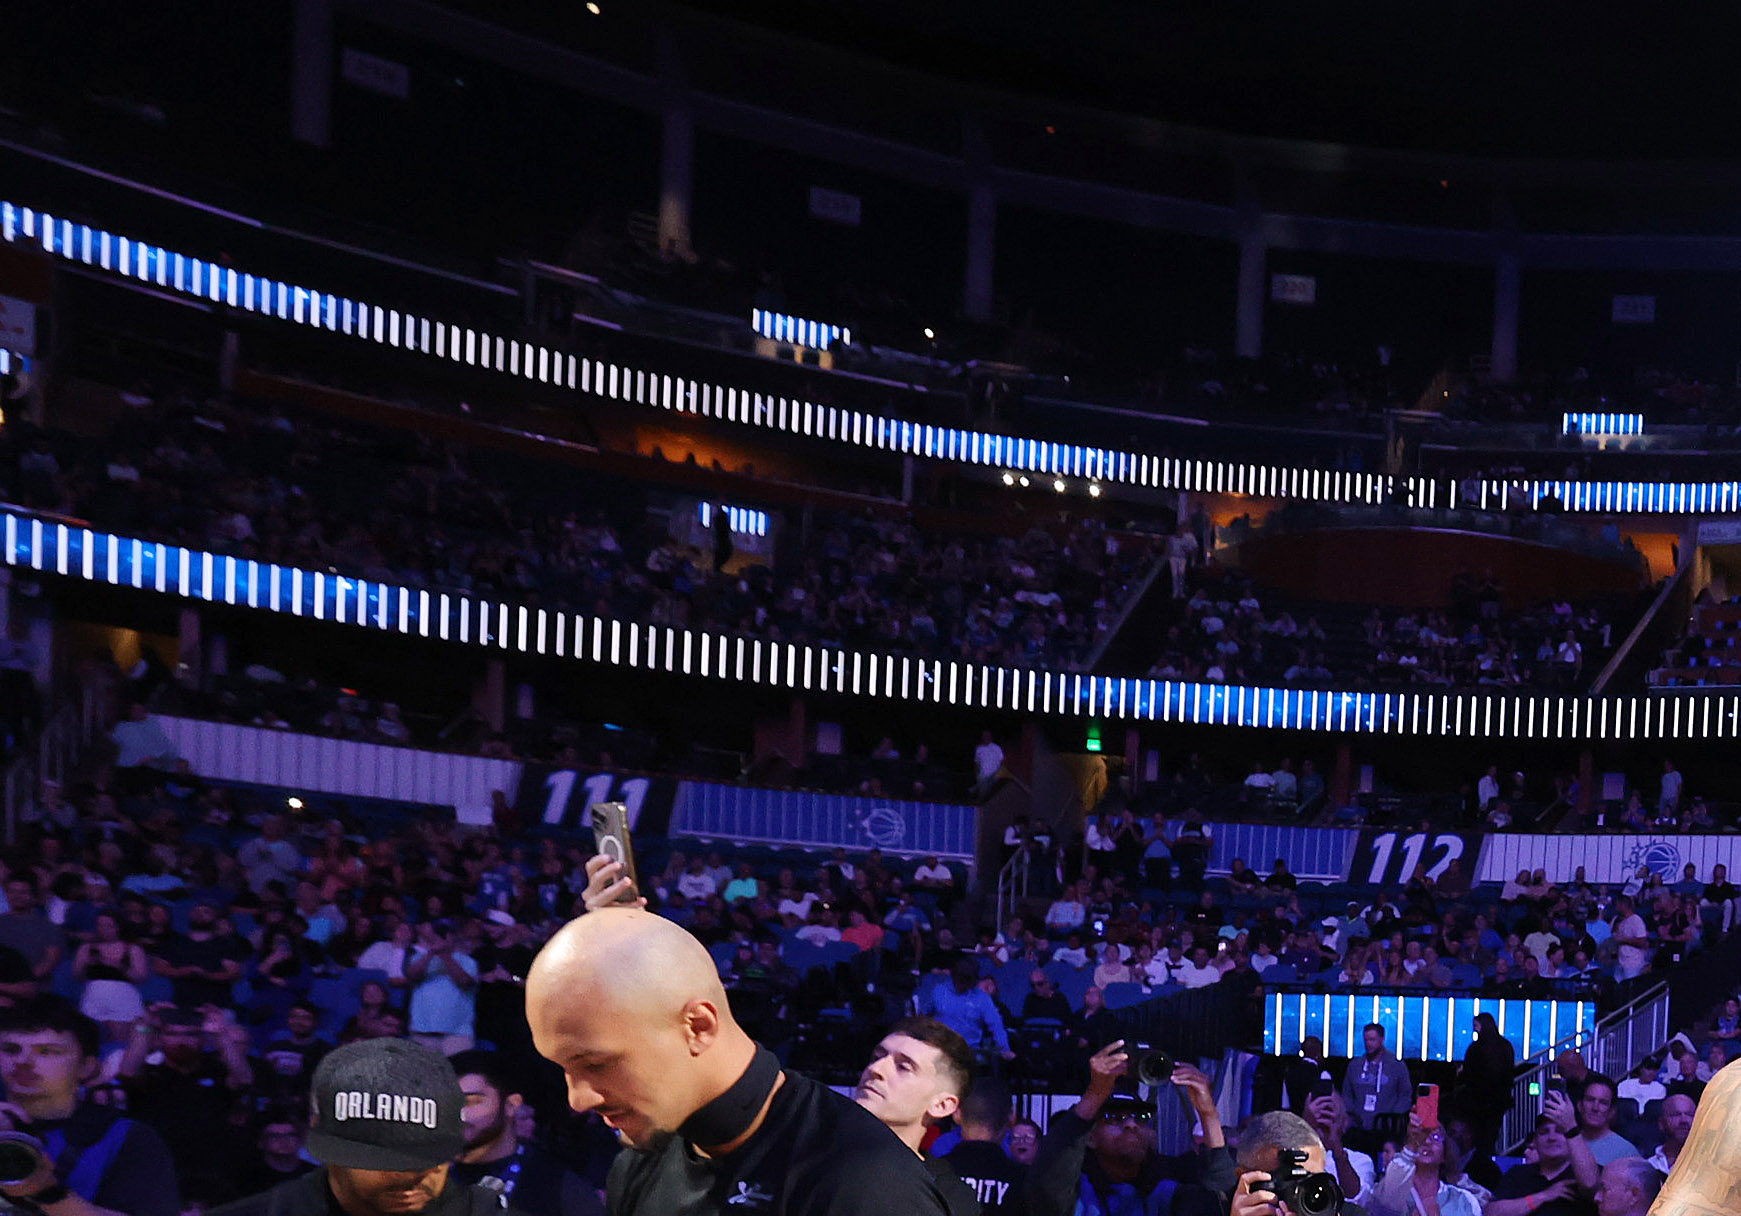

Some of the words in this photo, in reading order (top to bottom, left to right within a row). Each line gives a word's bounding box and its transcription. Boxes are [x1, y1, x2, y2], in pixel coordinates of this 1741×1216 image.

[543, 769, 650, 832] 111
[1367, 832, 1464, 884] 112
[335, 1091, 437, 1129] ORLANDO
